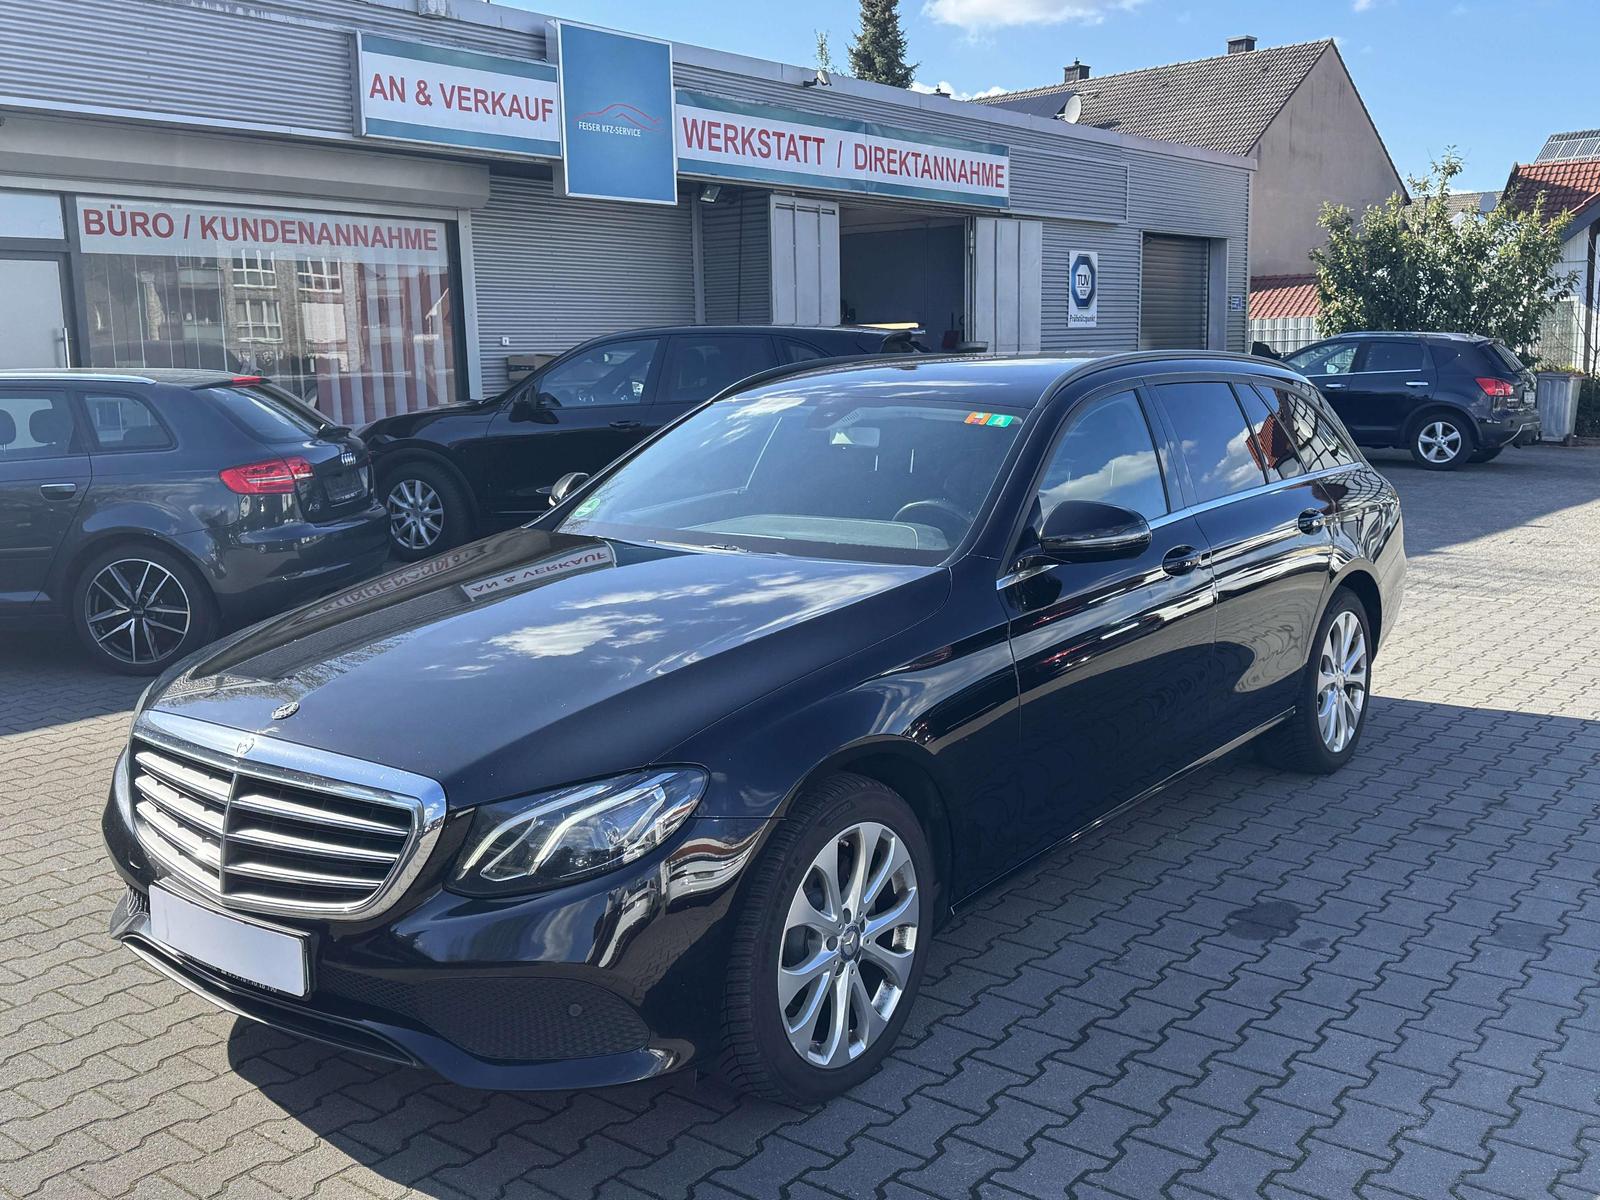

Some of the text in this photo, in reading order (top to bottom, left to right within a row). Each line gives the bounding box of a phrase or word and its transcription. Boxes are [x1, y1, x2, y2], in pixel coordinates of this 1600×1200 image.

[369, 73, 554, 122] AN & VERKAUF
[578, 121, 641, 137] FEISER KFZ-SERVICE
[682, 116, 1005, 189] WERKSTATT / DIREKTANNAHME
[83, 204, 437, 251] BÜRO / KUNDENANNAHME
